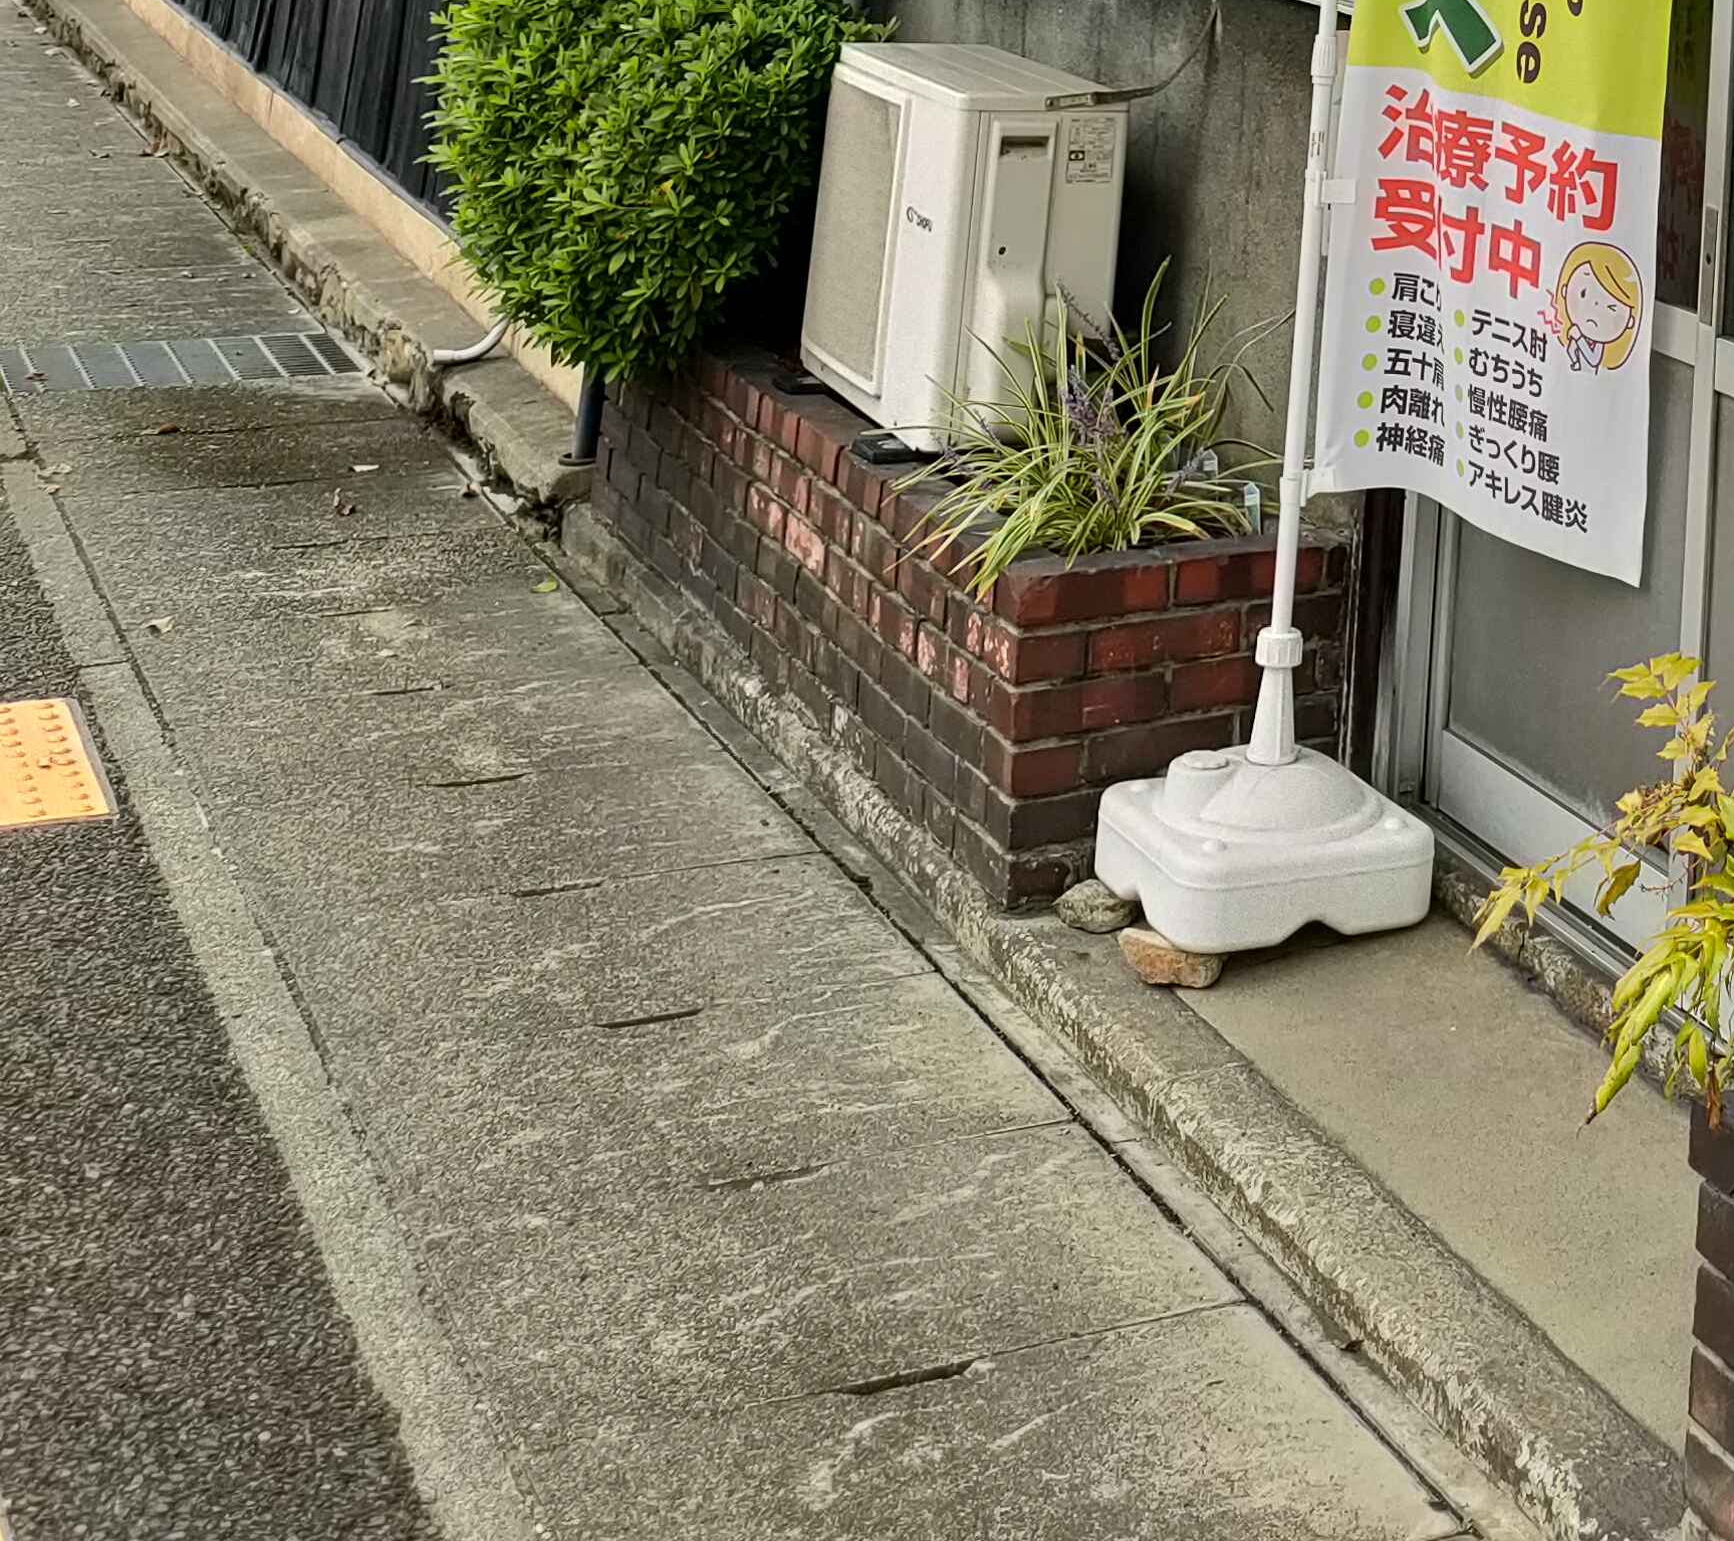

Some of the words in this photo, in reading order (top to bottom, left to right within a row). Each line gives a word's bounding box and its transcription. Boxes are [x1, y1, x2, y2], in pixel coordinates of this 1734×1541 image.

[1378, 84, 1618, 231] 治療予約
[1371, 178, 1541, 300] 受付中
[1470, 308, 1549, 363] テニス肘
[1383, 347, 1445, 392] 五十肩
[1468, 346, 1544, 398] むちうち
[1379, 384, 1446, 428] 肉離れ
[1466, 383, 1549, 443] 慢性腰痛
[1375, 422, 1446, 467] 神経痛
[1468, 424, 1560, 486] ぎっくり腰
[1467, 459, 1588, 534] アキレス腱炎
